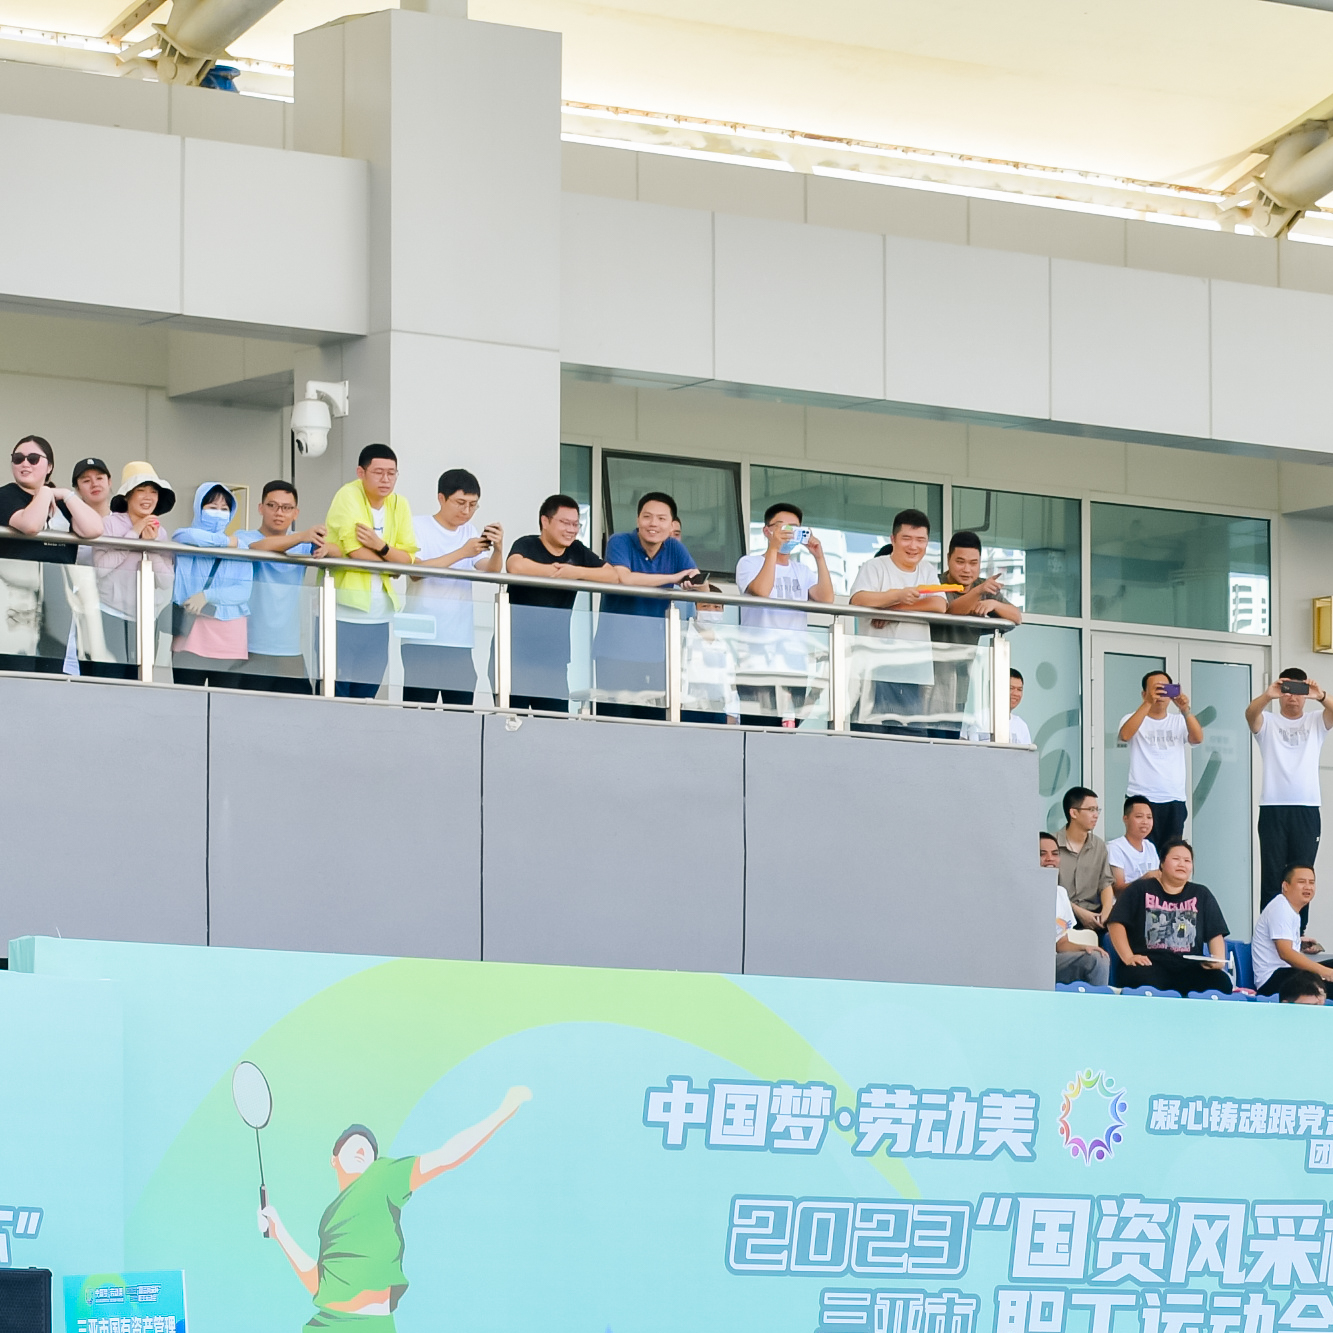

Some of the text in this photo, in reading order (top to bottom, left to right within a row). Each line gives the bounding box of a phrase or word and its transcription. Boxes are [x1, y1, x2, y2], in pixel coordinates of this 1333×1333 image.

[647, 1081, 1038, 1160] 中国梦·劳动美
